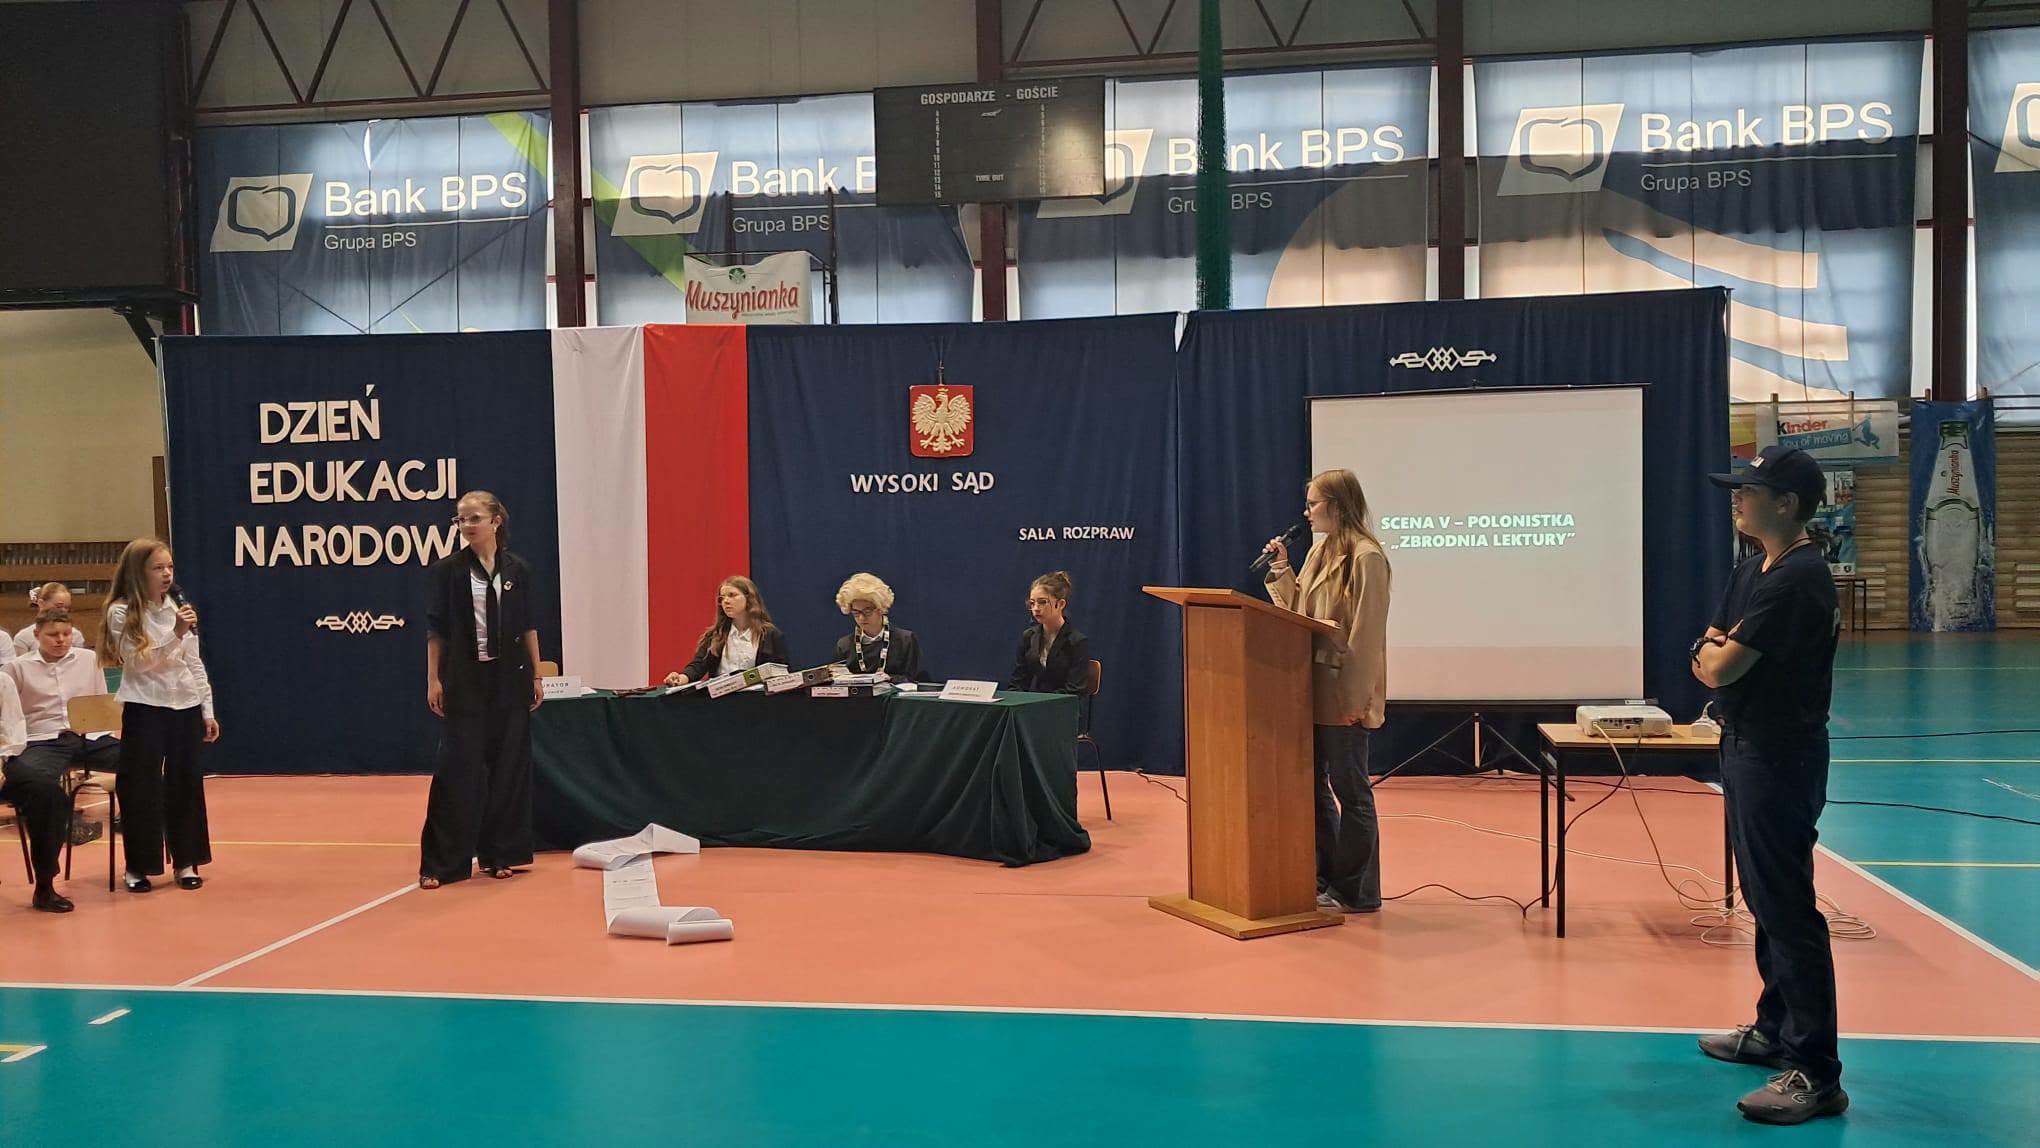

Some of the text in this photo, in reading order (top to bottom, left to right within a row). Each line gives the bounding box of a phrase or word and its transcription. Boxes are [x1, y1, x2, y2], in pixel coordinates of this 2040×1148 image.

[920, 90, 996, 105] GOSPODARZE
[1016, 86, 1059, 100] GOŚCIE
[1638, 102, 1893, 152] Bank BPS
[1168, 125, 1405, 176] Bnk BPS
[731, 157, 840, 198] Bank
[1640, 170, 1751, 193] Grupa BPS
[325, 171, 527, 217] Bank BPS
[1168, 192, 1273, 214] Gru BPS
[732, 214, 830, 235] Grupa BPS
[324, 232, 417, 252] Grupa BPS
[685, 280, 799, 320] Muszynianka
[259, 384, 381, 444] DZIEŃ
[250, 458, 458, 504] EDUKACJI
[850, 471, 995, 494] WYSOKI SĄD
[1018, 526, 1135, 541] SALA ROZPRAW
[1381, 516, 1434, 530] SCENA
[1438, 516, 1450, 529] V
[1467, 514, 1575, 528] POLONISTKA
[234, 525, 470, 567] NARODOW
[1391, 535, 1489, 550] „ZBRODNIA
[1493, 532, 1576, 546] LEKTURY”
